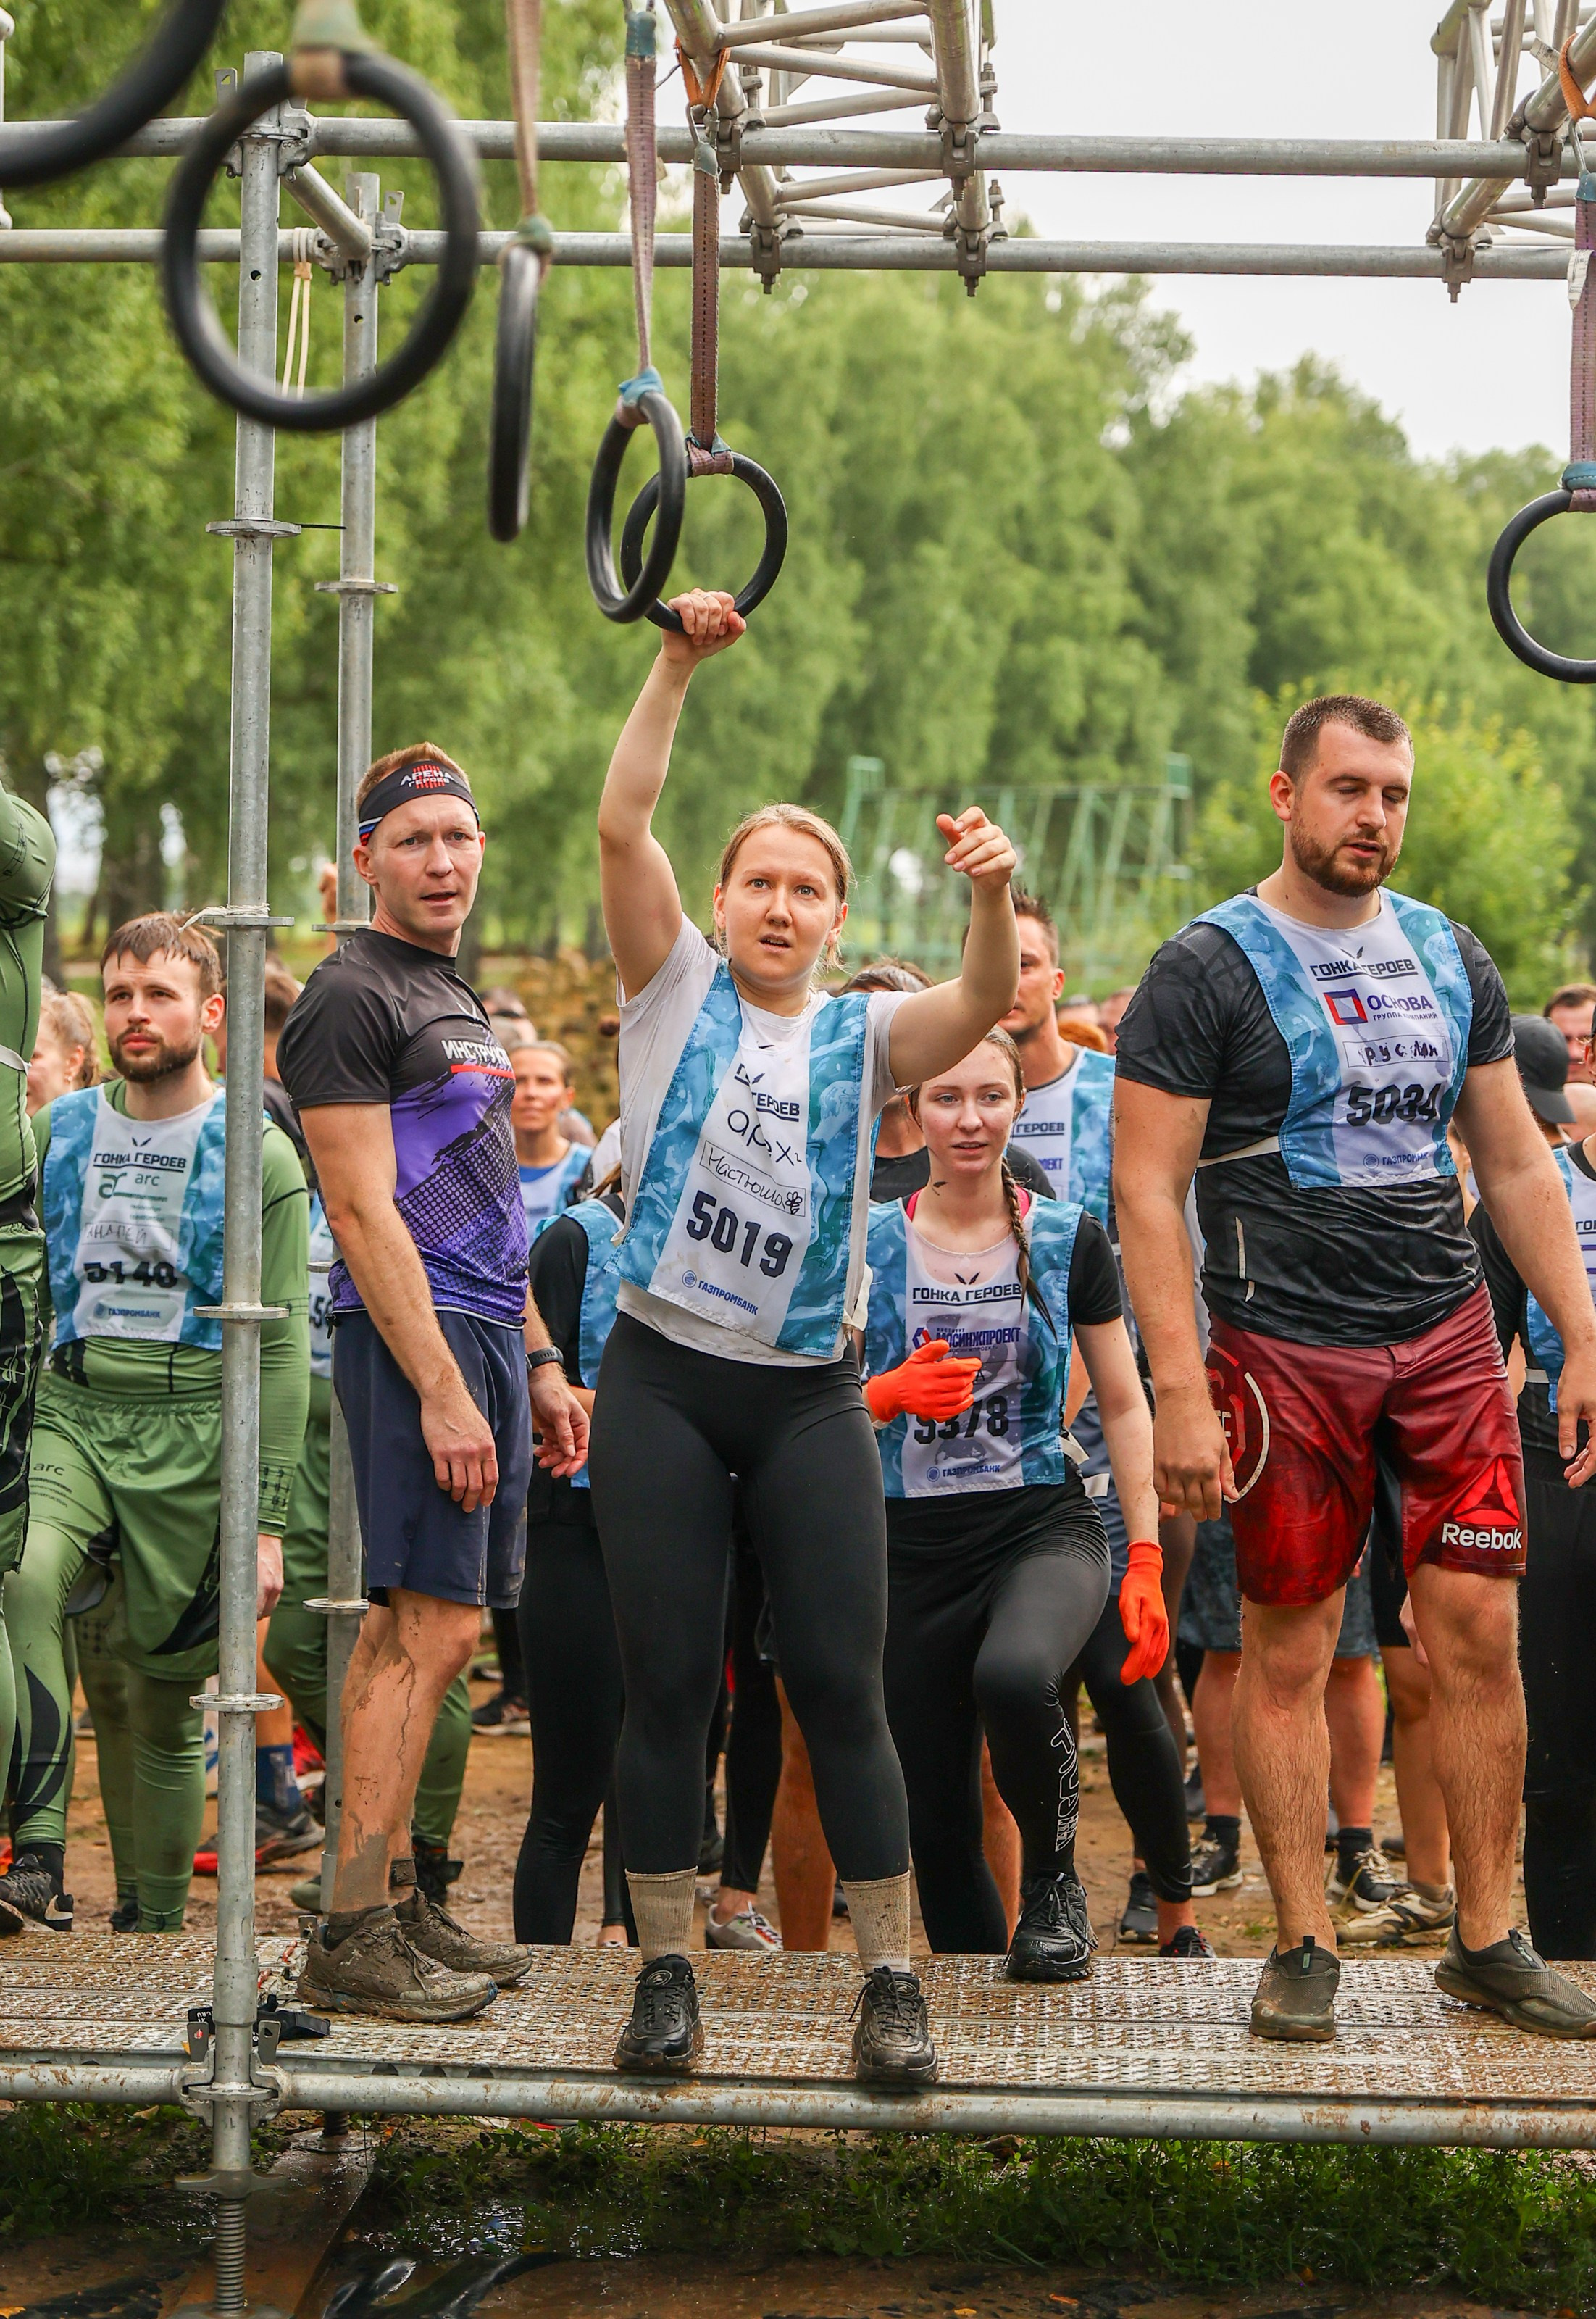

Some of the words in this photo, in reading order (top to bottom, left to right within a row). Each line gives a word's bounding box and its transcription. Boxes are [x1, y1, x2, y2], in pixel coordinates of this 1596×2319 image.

[400, 770, 455, 786] АРЕНА
[409, 777, 449, 788] ГЕРОЕВ
[1310, 959, 1362, 976] ГОНКА
[1361, 959, 1416, 975] ГЕРОЕВ
[1367, 994, 1433, 1011] ОСНОВА
[1373, 1012, 1403, 1021] ГРУППА
[1347, 1083, 1441, 1126] 5034
[1016, 1123, 1065, 1132] ГЕРОЕВ
[93, 1153, 130, 1165] ГОНКА
[134, 1152, 187, 1168] ГЕРОЕВ
[1382, 1152, 1429, 1165] ГАЗПРОМБАНК
[135, 1173, 160, 1186] arc
[686, 1190, 793, 1278] 5019
[83, 1261, 178, 1288] 5140
[698, 1280, 759, 1316] ГАЗПРОМБАНК
[913, 1288, 961, 1302] ГОНКА
[966, 1283, 1021, 1301] ГЕРОЕВ
[108, 1307, 160, 1318] ГАЗПРОМБАНК
[33, 1463, 65, 1476] arc
[943, 1465, 1000, 1477] ГАЗПРОМБАНК
[1442, 1523, 1523, 1550] Reebok
